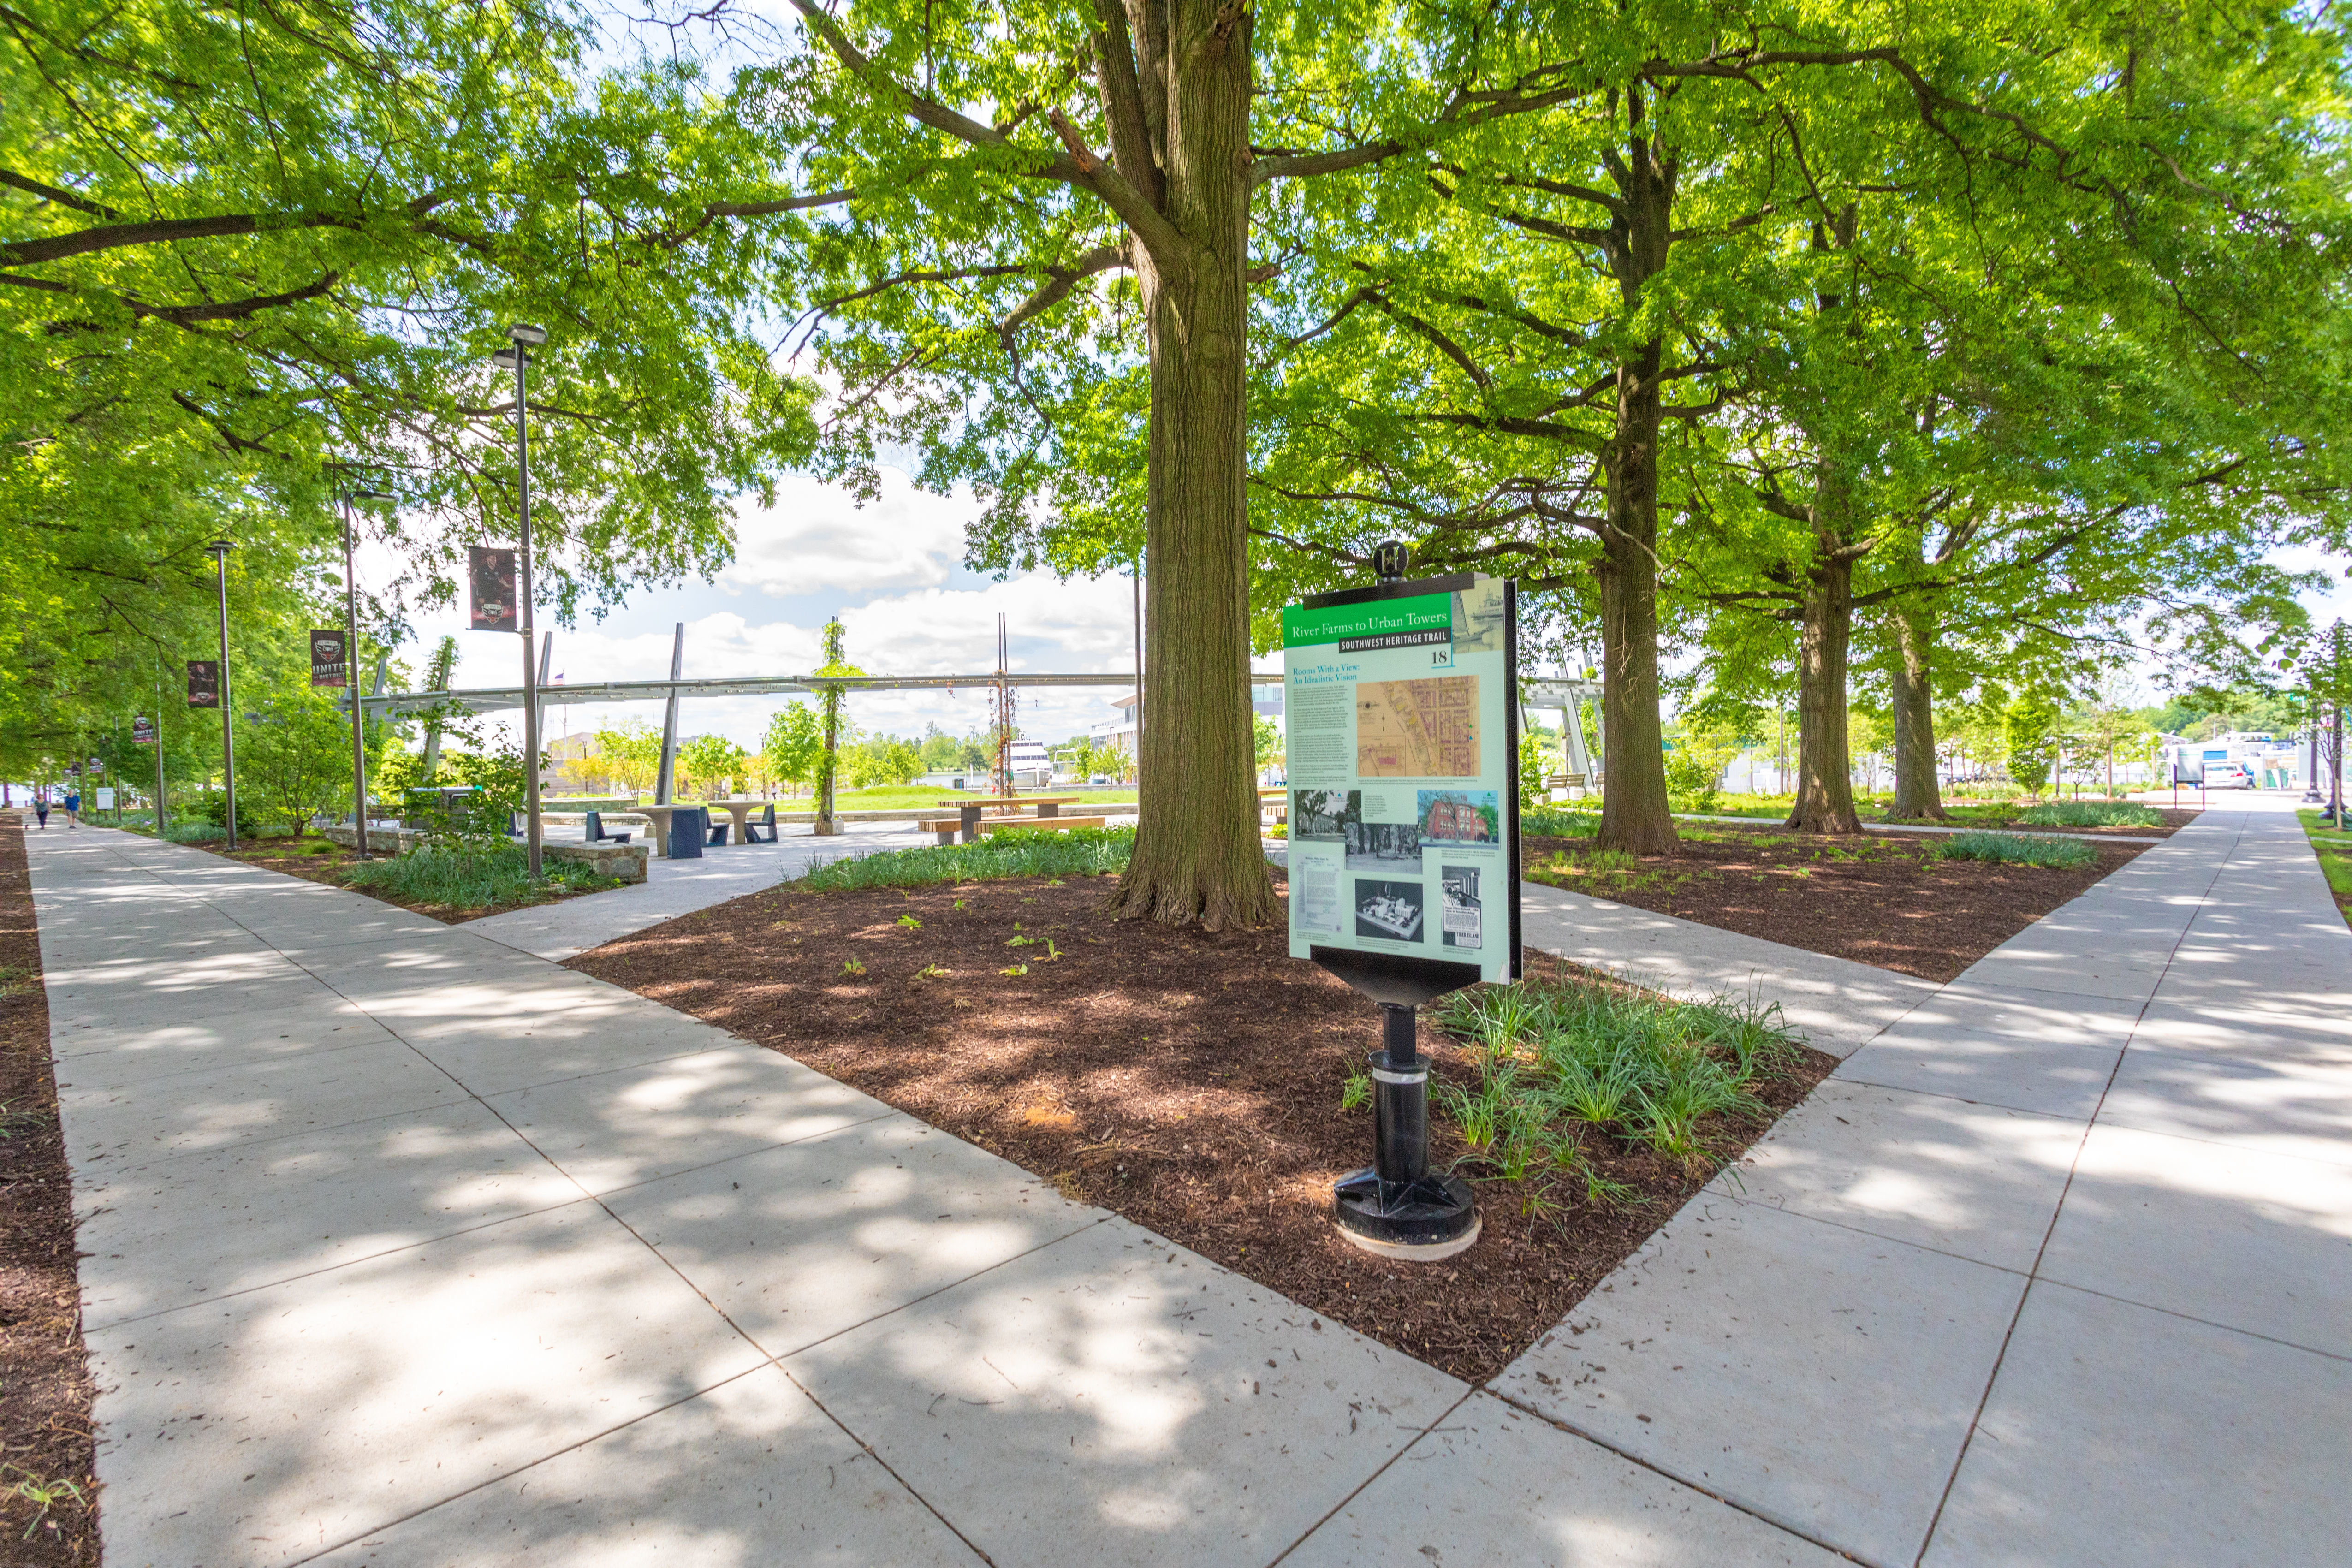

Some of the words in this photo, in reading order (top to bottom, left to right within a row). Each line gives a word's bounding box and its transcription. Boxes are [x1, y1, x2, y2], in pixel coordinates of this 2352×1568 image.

[1292, 626, 1319, 638] River
[1322, 623, 1353, 635] Farms
[1356, 622, 1366, 631] to
[1368, 616, 1403, 629] Urban
[1406, 612, 1447, 625] Towers
[1342, 637, 1384, 650] SOUTHWEST
[1386, 633, 1421, 646] HERITAGE
[1424, 631, 1446, 642] TRAIL
[1431, 650, 1447, 664] 18
[312, 663, 345, 674] UNITE
[1317, 665, 1334, 673] With
[1341, 663, 1360, 671] View:
[1304, 674, 1334, 683] Idealistic
[1335, 673, 1357, 681] Vision
